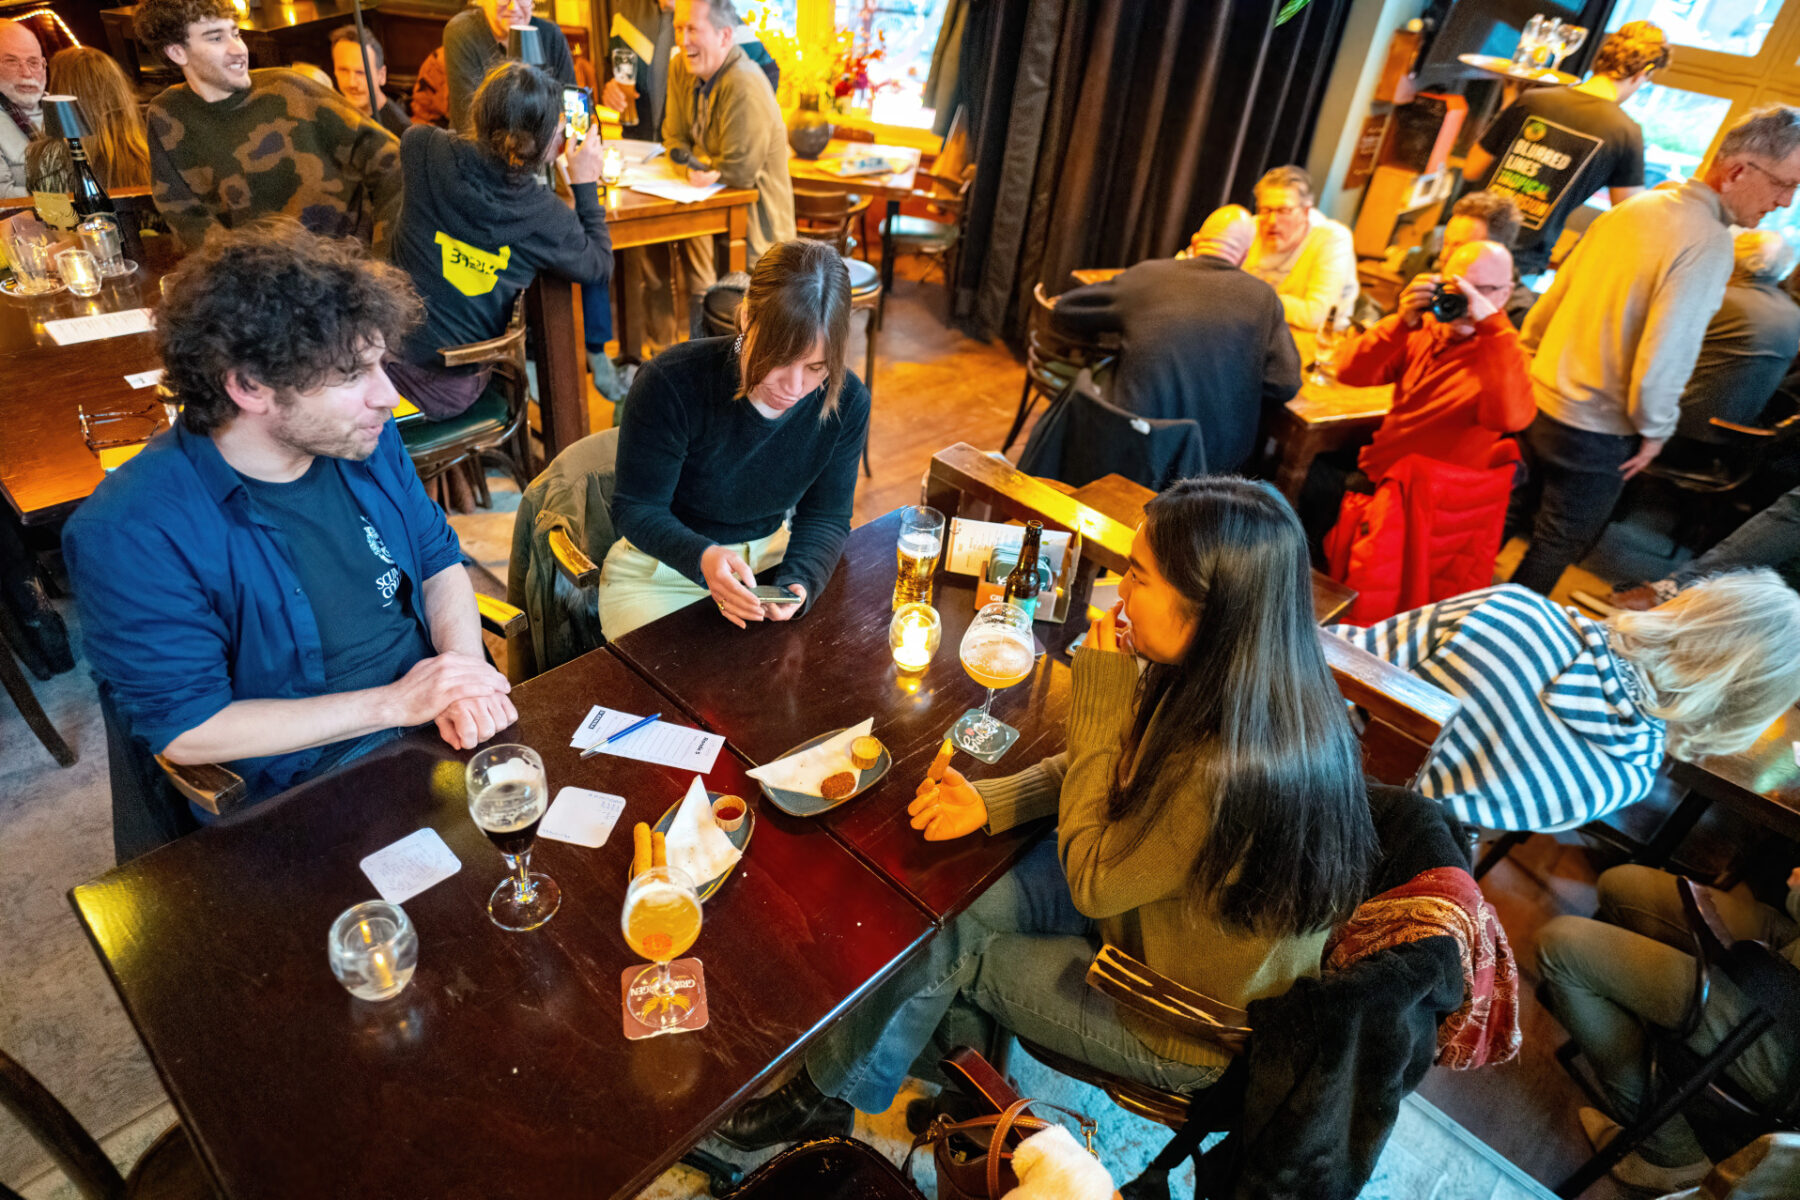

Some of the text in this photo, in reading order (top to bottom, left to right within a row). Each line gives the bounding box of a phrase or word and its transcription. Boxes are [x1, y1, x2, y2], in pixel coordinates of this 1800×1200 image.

[1504, 154, 1541, 177] LINES
[1513, 139, 1571, 170] BLURRED
[630, 979, 696, 997] GRIRGEN
